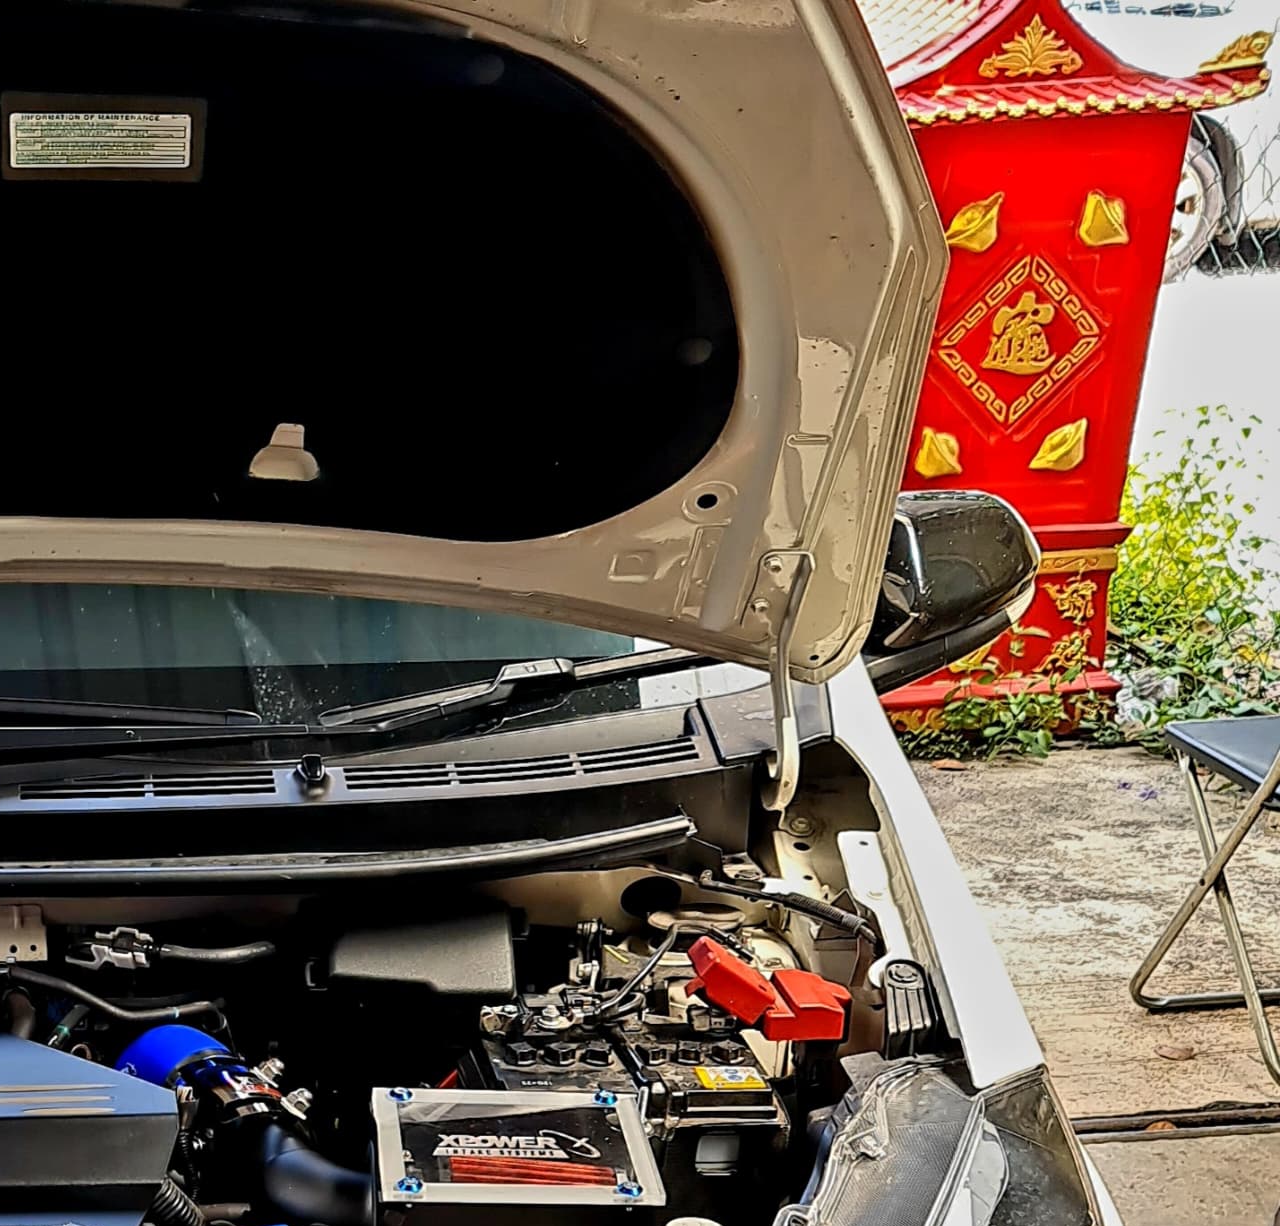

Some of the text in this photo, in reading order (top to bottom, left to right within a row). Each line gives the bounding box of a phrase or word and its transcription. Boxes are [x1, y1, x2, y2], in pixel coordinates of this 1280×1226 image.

[98, 114, 161, 122] MAINTENANCE
[438, 1133, 561, 1149] XPOWER
[498, 1149, 555, 1158] SYSTEMS
